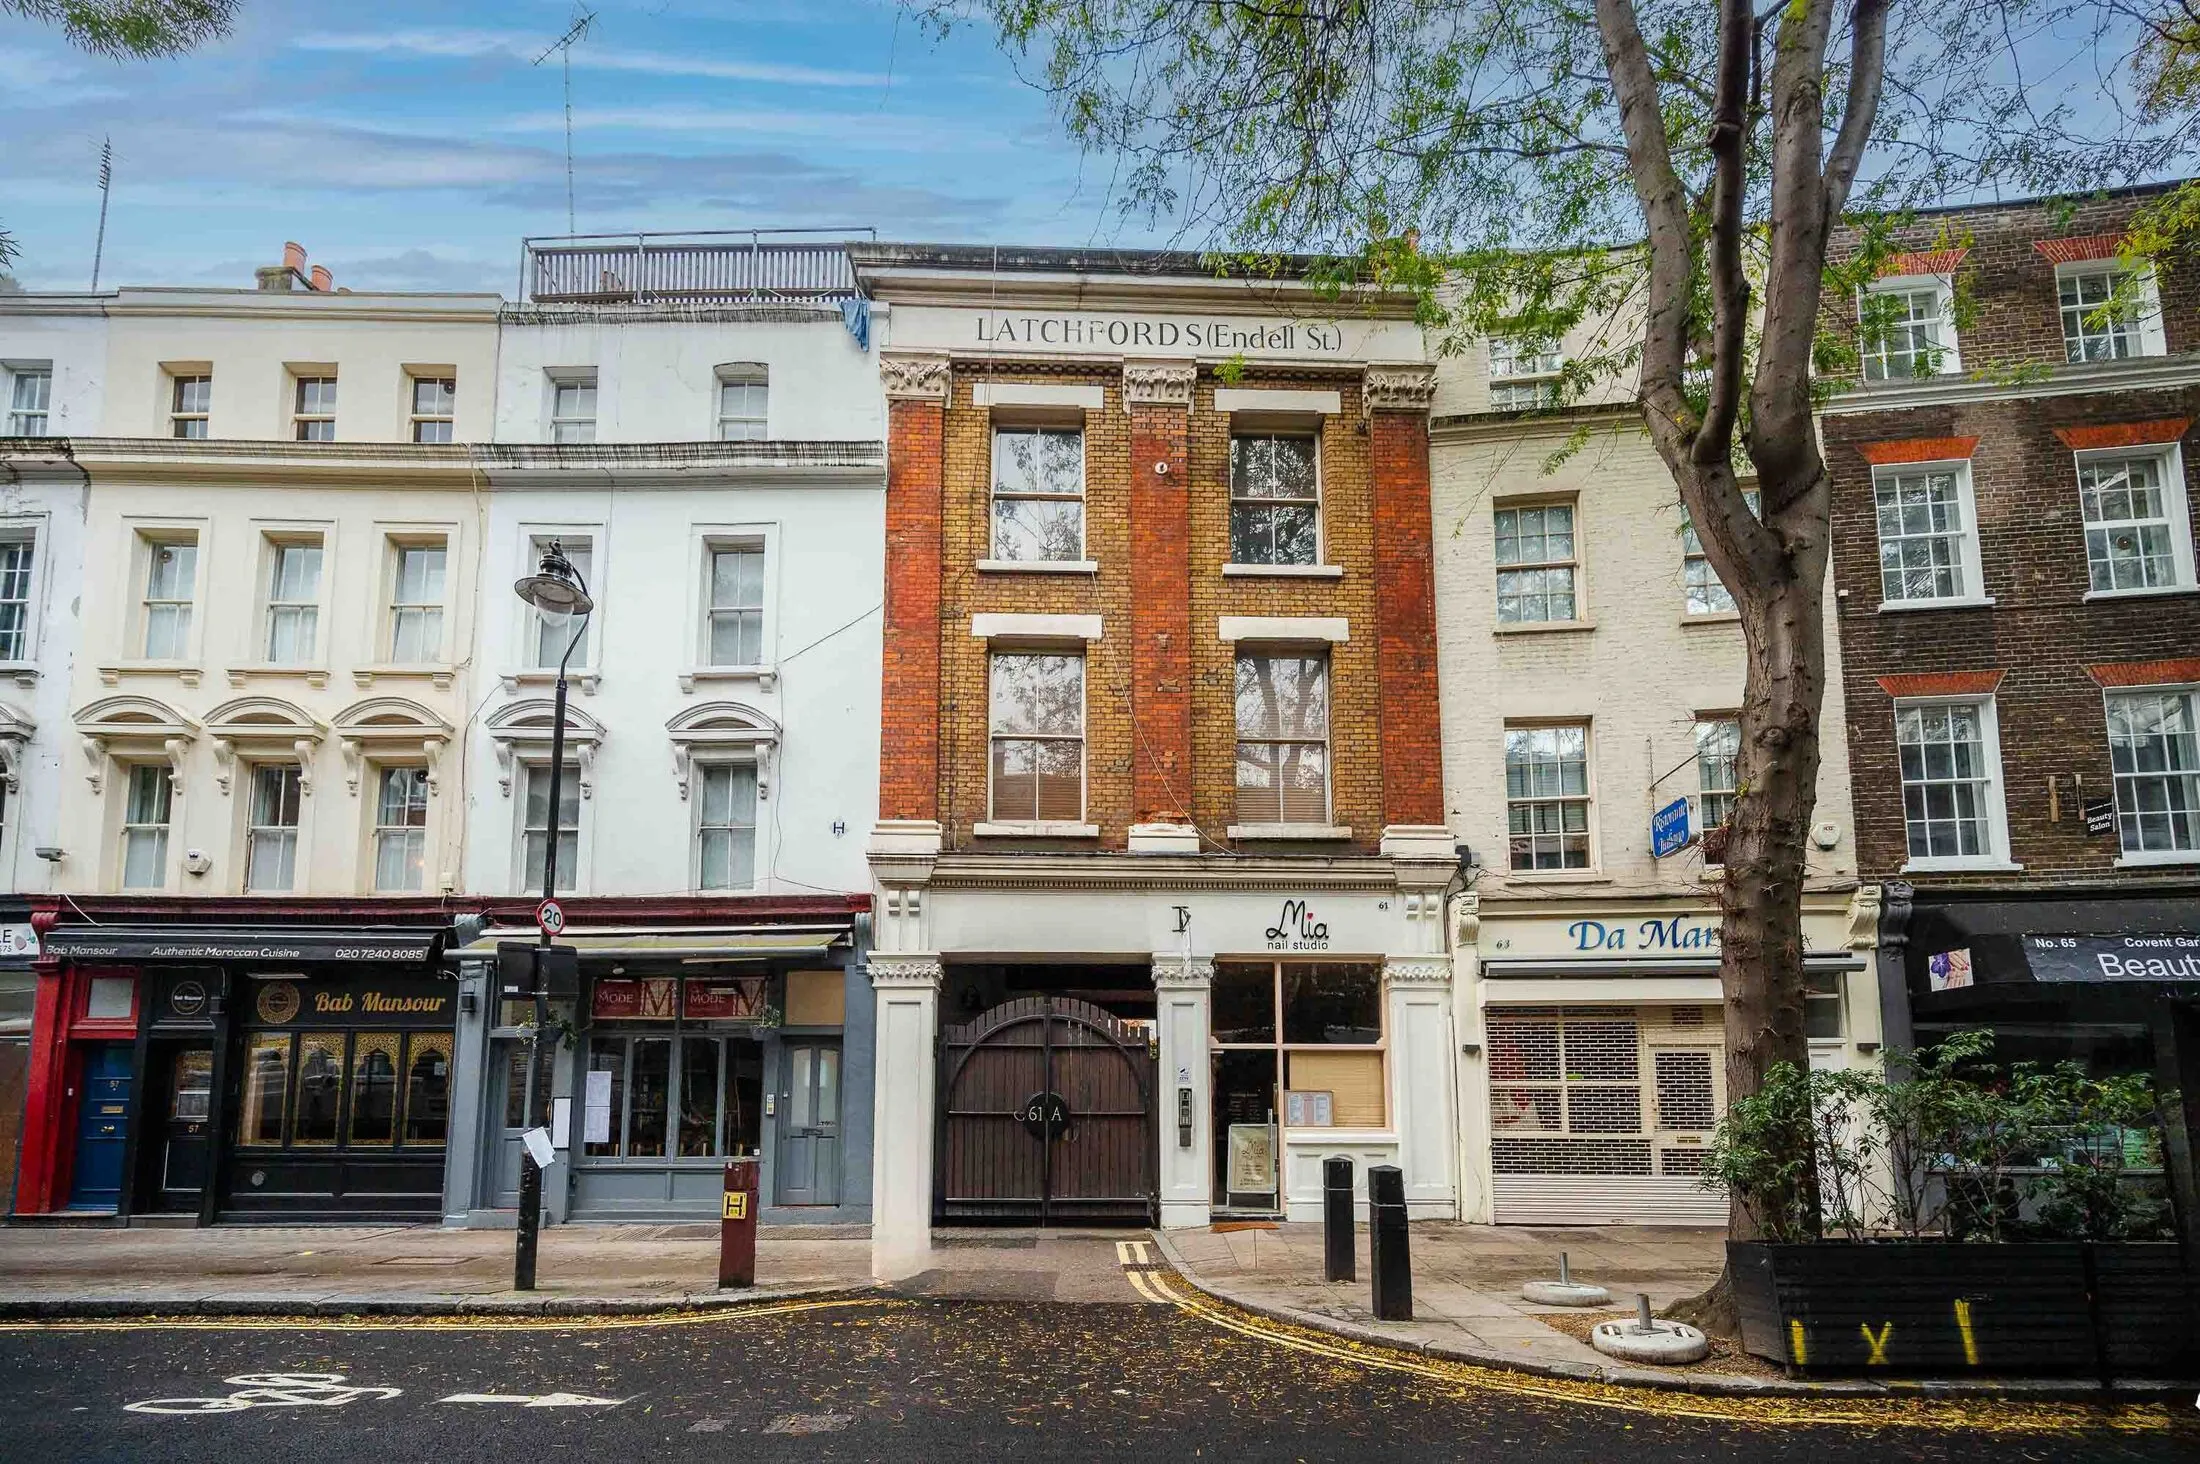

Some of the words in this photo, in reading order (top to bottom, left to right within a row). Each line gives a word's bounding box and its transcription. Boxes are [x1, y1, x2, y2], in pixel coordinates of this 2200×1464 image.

[1307, 325, 1342, 351] St.)
[2087, 812, 2113, 824] Beauty
[2090, 821, 2111, 832] Salon
[1378, 901, 1389, 910] 61
[543, 908, 562, 926] 20
[1265, 899, 1329, 939] Mia
[0, 929, 13, 943] E
[1568, 920, 1626, 950] Da
[1267, 940, 1288, 950] nail
[1292, 940, 1329, 950] studio
[1496, 939, 1510, 950] 63
[2035, 938, 2059, 948] No.
[2060, 938, 2077, 948] 65
[2124, 937, 2173, 948] Covent
[45, 945, 68, 955] Bab
[69, 945, 118, 955] Mansour
[150, 946, 203, 957] Authentic
[204, 947, 258, 958] Moroccan
[260, 948, 300, 958] Cuisine
[335, 949, 359, 959] 020
[361, 949, 391, 959] 7240
[391, 950, 424, 959] 8085
[315, 992, 353, 1012] Bab
[361, 992, 446, 1013] Mansour
[599, 991, 633, 1004] MODE
[690, 992, 725, 1004] MODE
[1028, 1106, 1043, 1122] 61
[1051, 1106, 1063, 1122] A
[188, 1124, 199, 1133] 57
[726, 1195, 744, 1217] H
